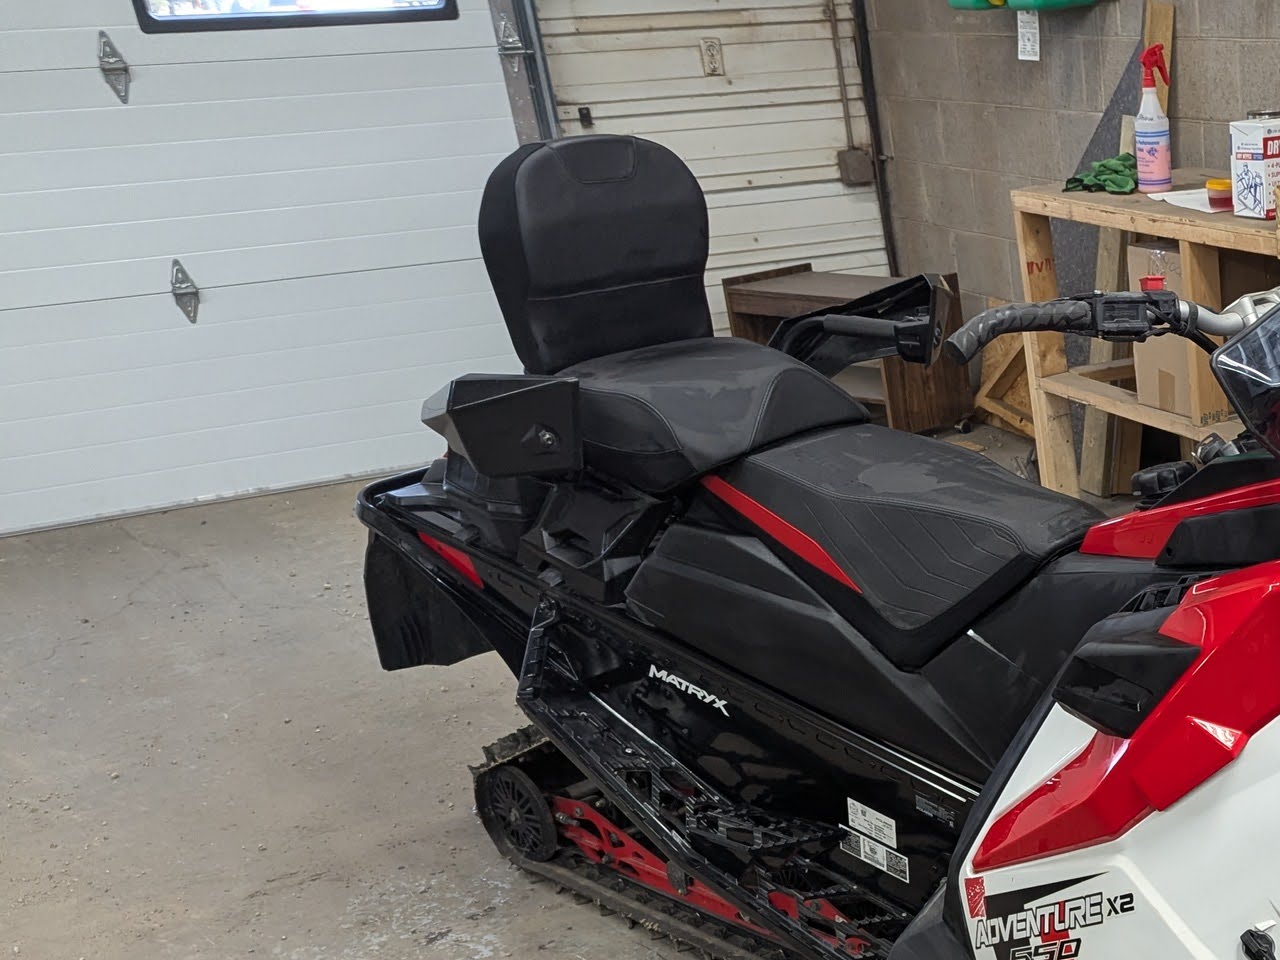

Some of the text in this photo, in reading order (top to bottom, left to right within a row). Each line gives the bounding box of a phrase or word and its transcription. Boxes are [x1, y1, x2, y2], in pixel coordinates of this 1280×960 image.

[648, 664, 730, 717] MATRYX
[975, 891, 1135, 949] ADVENTURE X2
